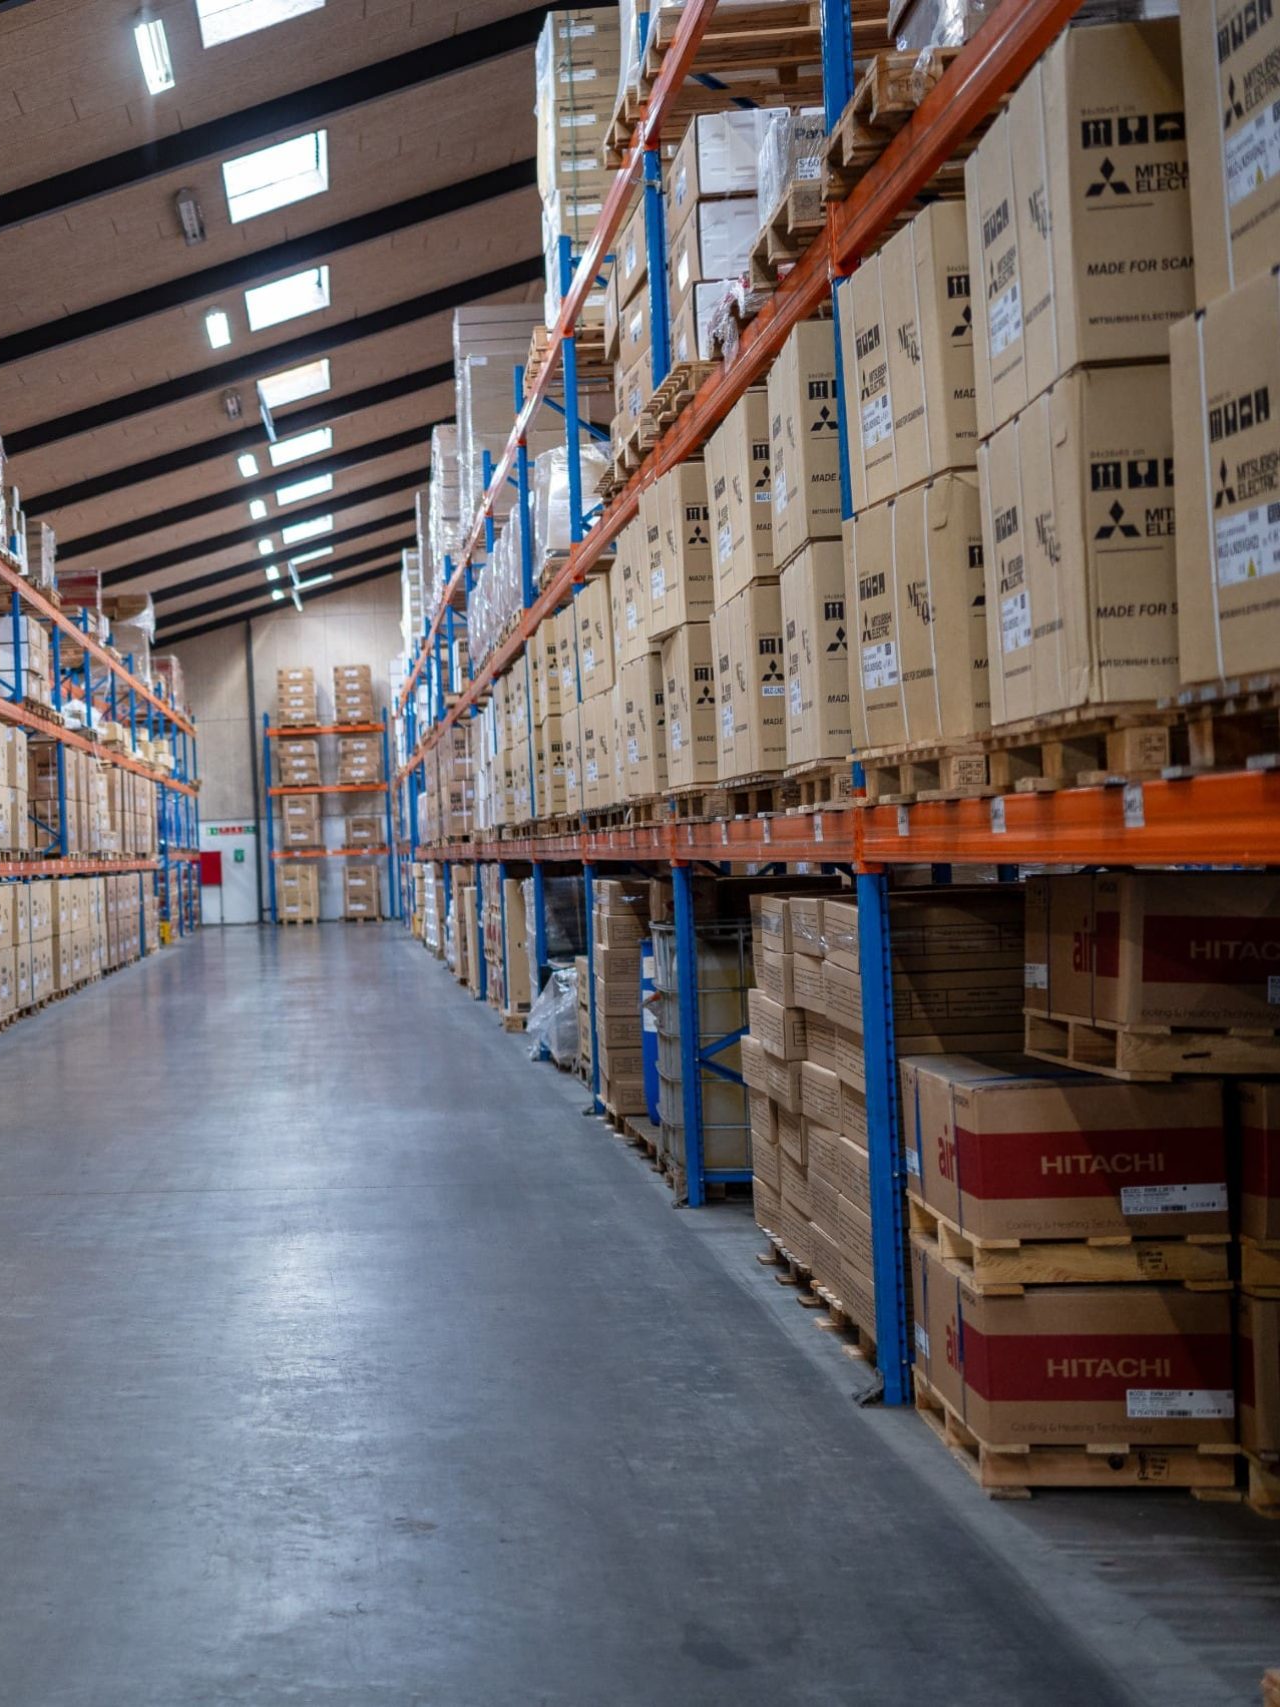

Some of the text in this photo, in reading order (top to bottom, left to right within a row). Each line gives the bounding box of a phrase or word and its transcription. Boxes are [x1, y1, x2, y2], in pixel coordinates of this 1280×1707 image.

[1135, 162, 1189, 179] MITSU
[1135, 178, 1189, 194] ELECT
[1087, 256, 1195, 277] MADE FOR SCAN
[1089, 313, 1140, 325] MITSUBISHI
[954, 387, 976, 400] MAD
[955, 431, 978, 439] MITSU
[812, 473, 837, 482] MADE
[1238, 472, 1280, 501] ELECTRIC
[1145, 506, 1175, 522] MIT
[1146, 522, 1175, 538] ELE
[1096, 603, 1167, 619] MADE FOR
[1150, 655, 1179, 666] ELECT
[1190, 939, 1280, 961] HITAC
[1141, 1006, 1172, 1018] ooling
[1040, 1151, 1165, 1175] HITACHI
[1006, 1218, 1148, 1231] Cooling & Heating Technology
[1047, 1357, 1171, 1379] HITACHI
[1010, 1422, 1153, 1434] Cooling & Heating Technology
